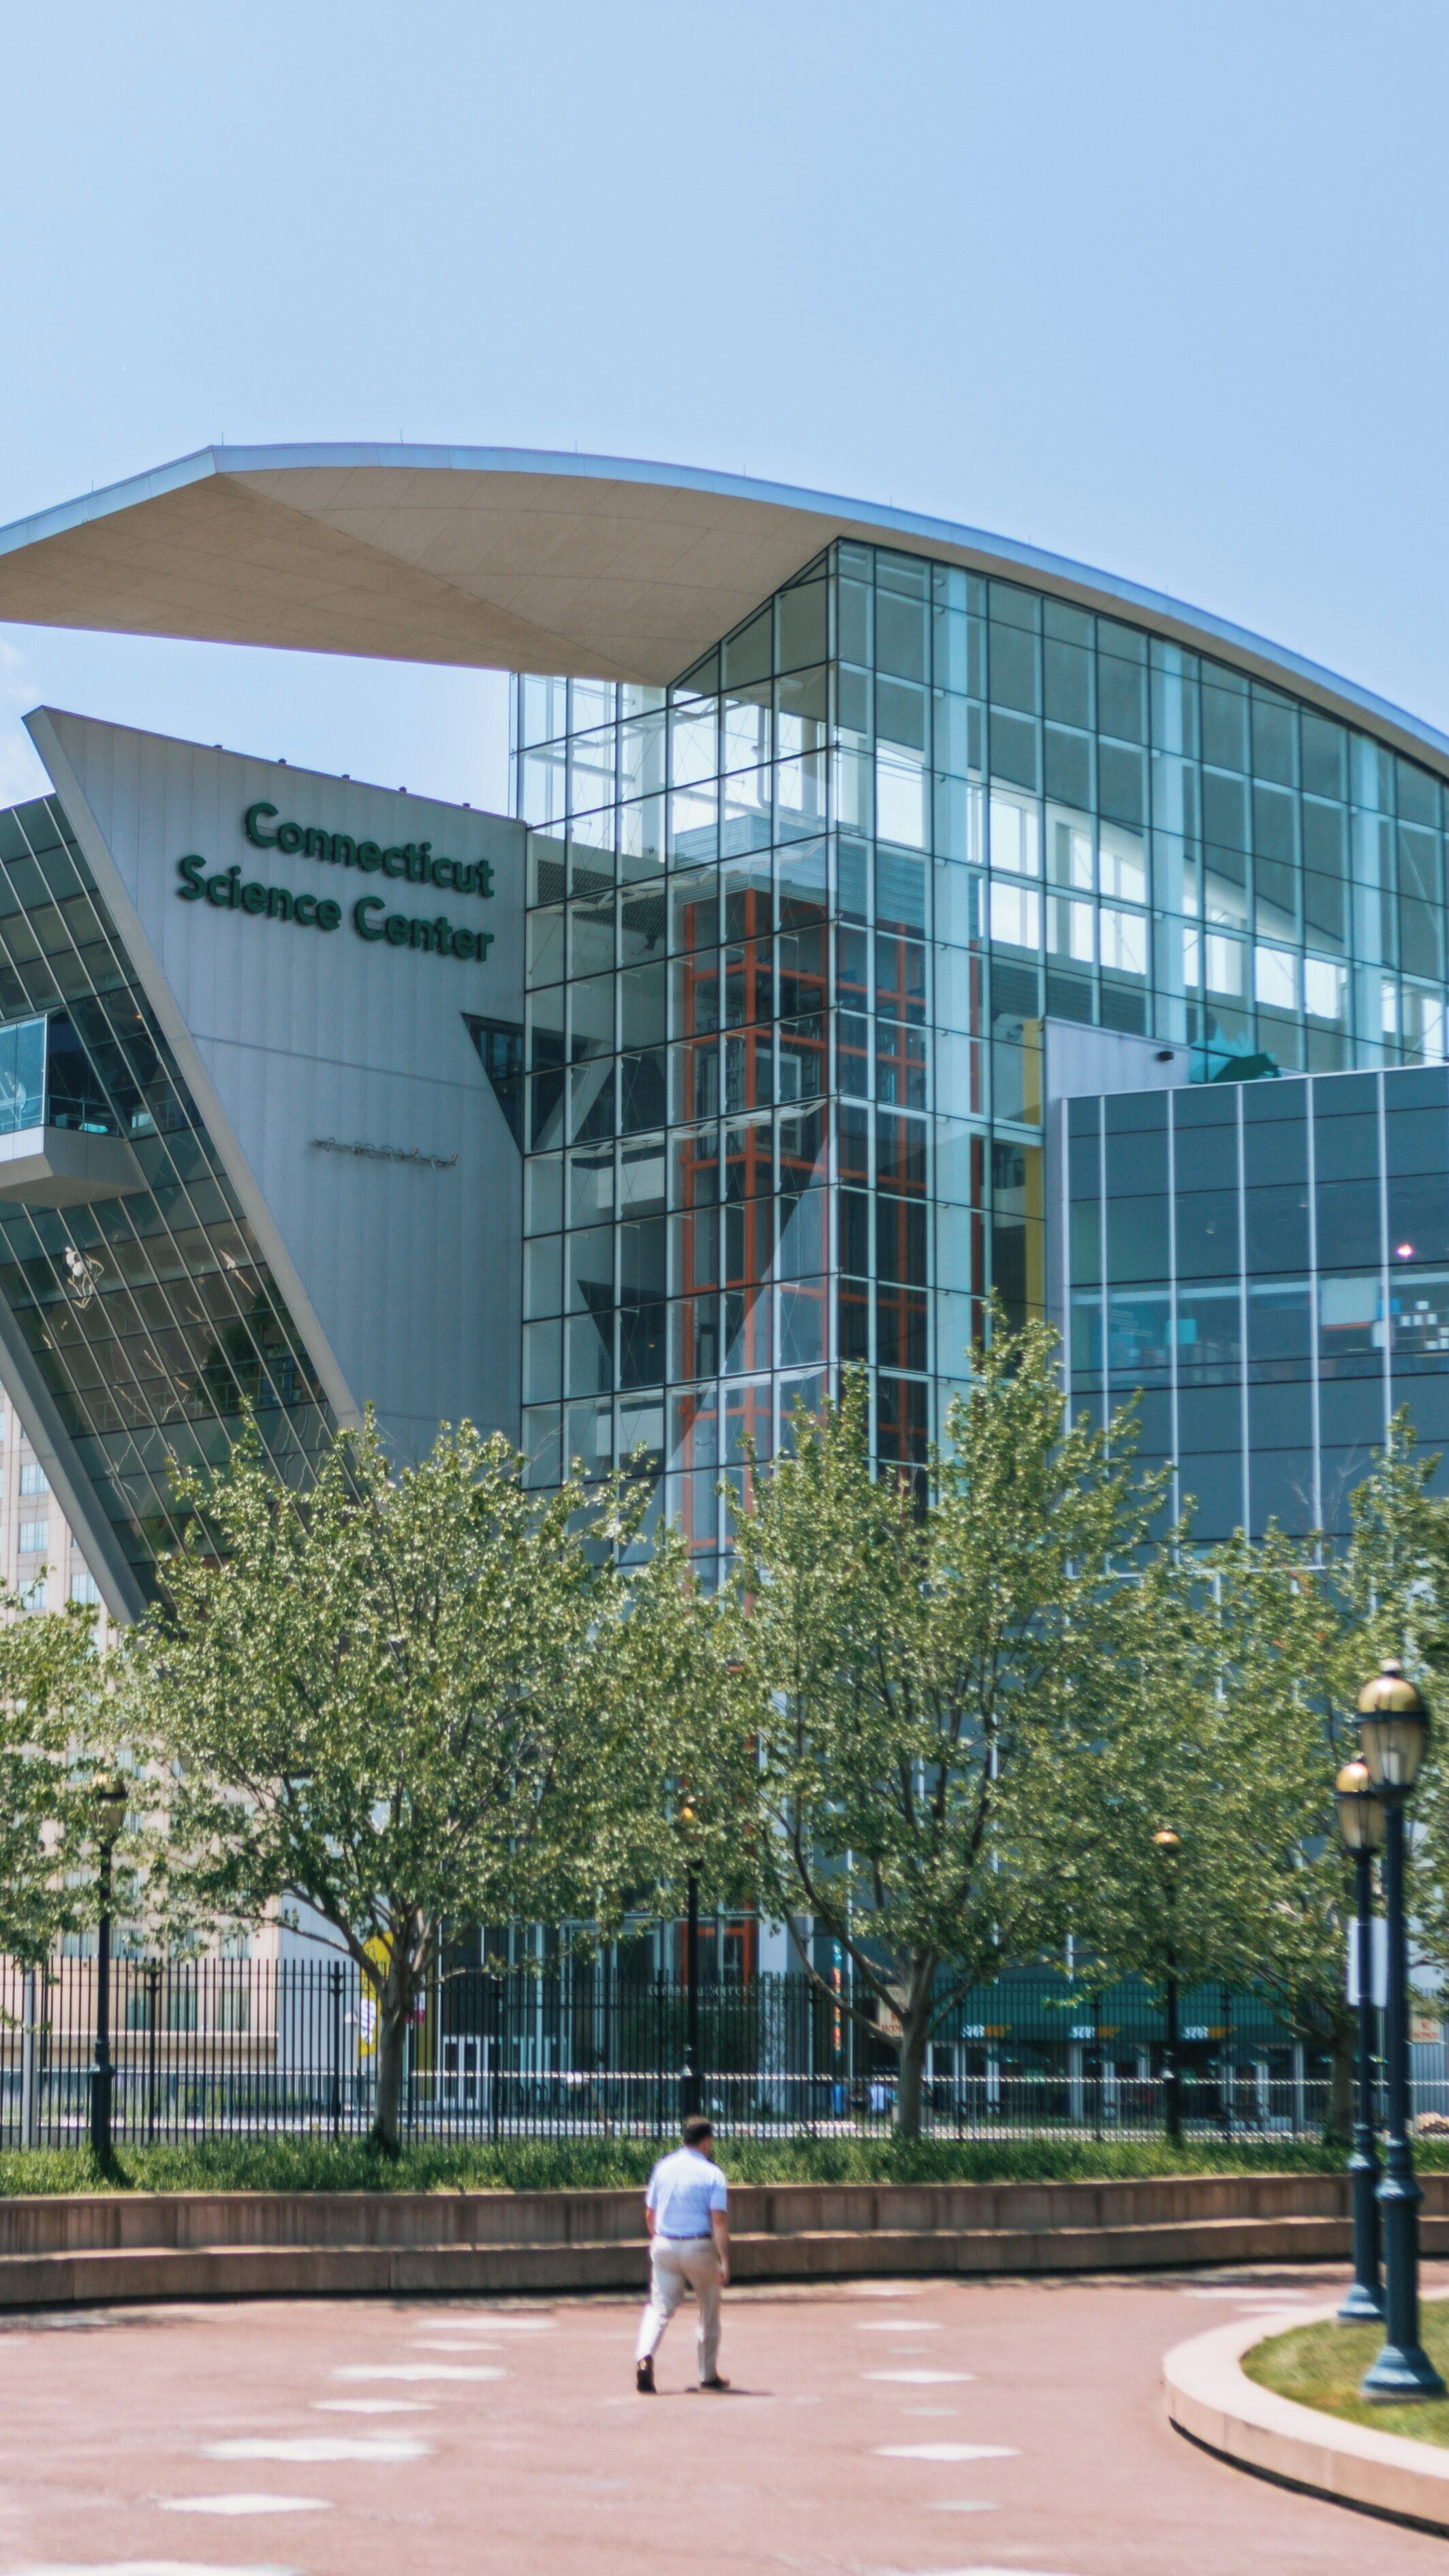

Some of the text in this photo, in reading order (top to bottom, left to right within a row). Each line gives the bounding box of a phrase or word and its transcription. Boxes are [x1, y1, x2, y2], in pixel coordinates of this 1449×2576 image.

[246, 802, 495, 897] Connecticut
[178, 854, 495, 961] Science Center
